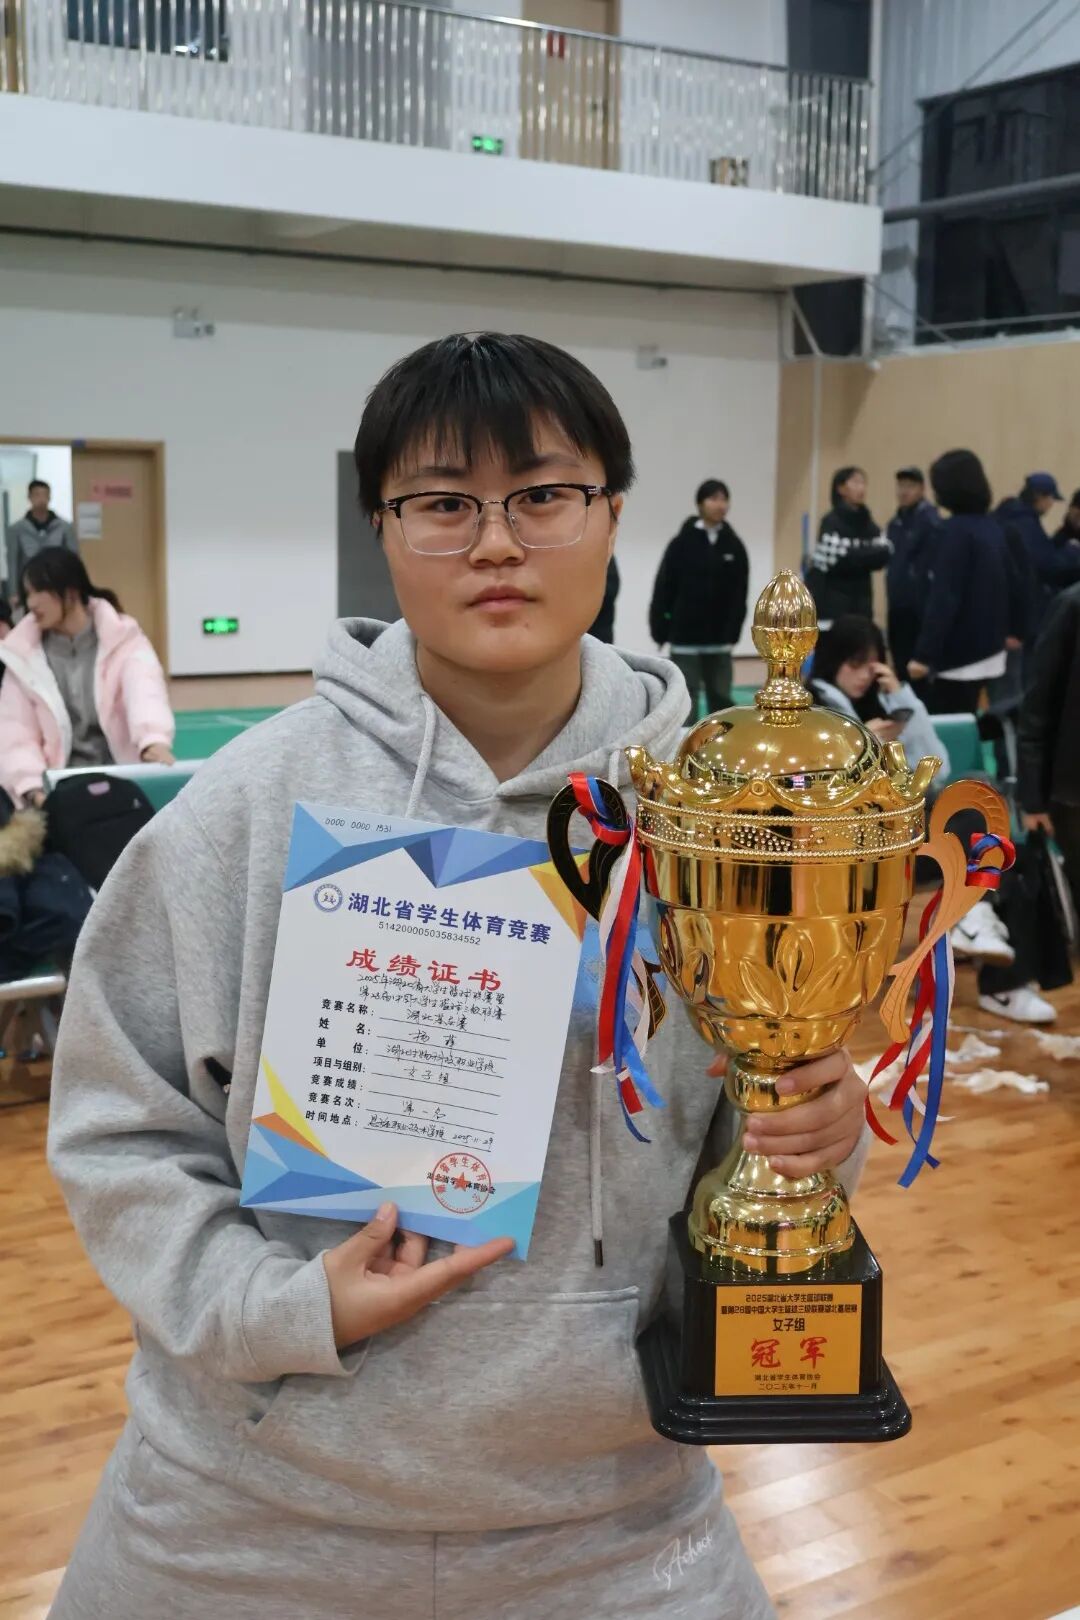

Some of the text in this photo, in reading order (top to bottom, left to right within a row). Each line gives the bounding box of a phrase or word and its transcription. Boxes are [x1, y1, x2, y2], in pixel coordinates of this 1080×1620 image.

[347, 892, 552, 945] 湖北省学生体育竞赛
[345, 948, 502, 991] 成绩证书
[321, 998, 374, 1016] 竞赛名称：
[310, 1074, 363, 1091] 竞赛成绩：
[308, 1092, 361, 1109] 竞赛名次：
[305, 1110, 358, 1127] 时间地点：
[772, 1317, 806, 1332] 女子组
[750, 1336, 828, 1369] 冠军
